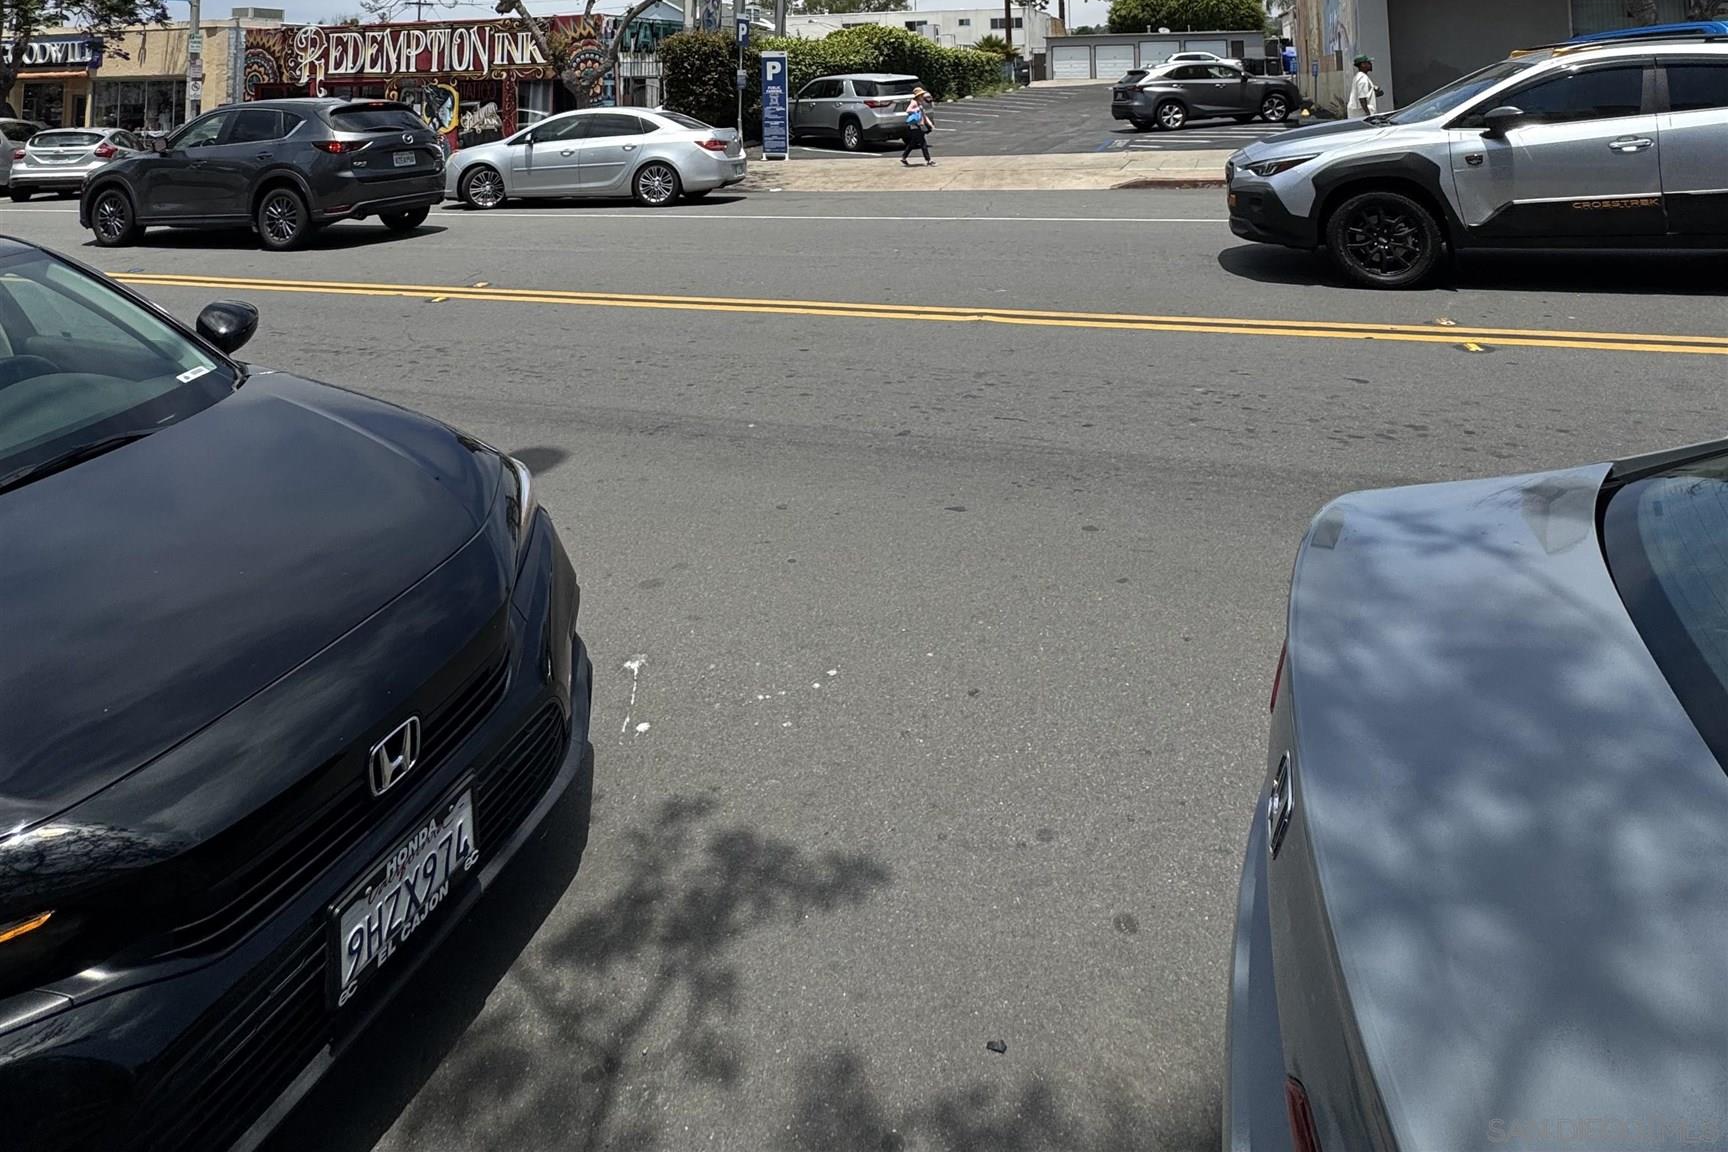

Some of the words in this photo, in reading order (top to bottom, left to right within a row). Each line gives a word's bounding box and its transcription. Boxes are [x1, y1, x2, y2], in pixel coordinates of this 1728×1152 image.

[294, 26, 490, 97] REDEMPTION
[493, 31, 547, 65] INK
[738, 23, 748, 42] P
[766, 61, 782, 81] P
[1572, 198, 1659, 209] CROSSTREK
[386, 818, 438, 879] HONDA
[343, 819, 471, 988] 9HZX974
[377, 942, 396, 968] EL
[401, 881, 449, 942] CAJON
